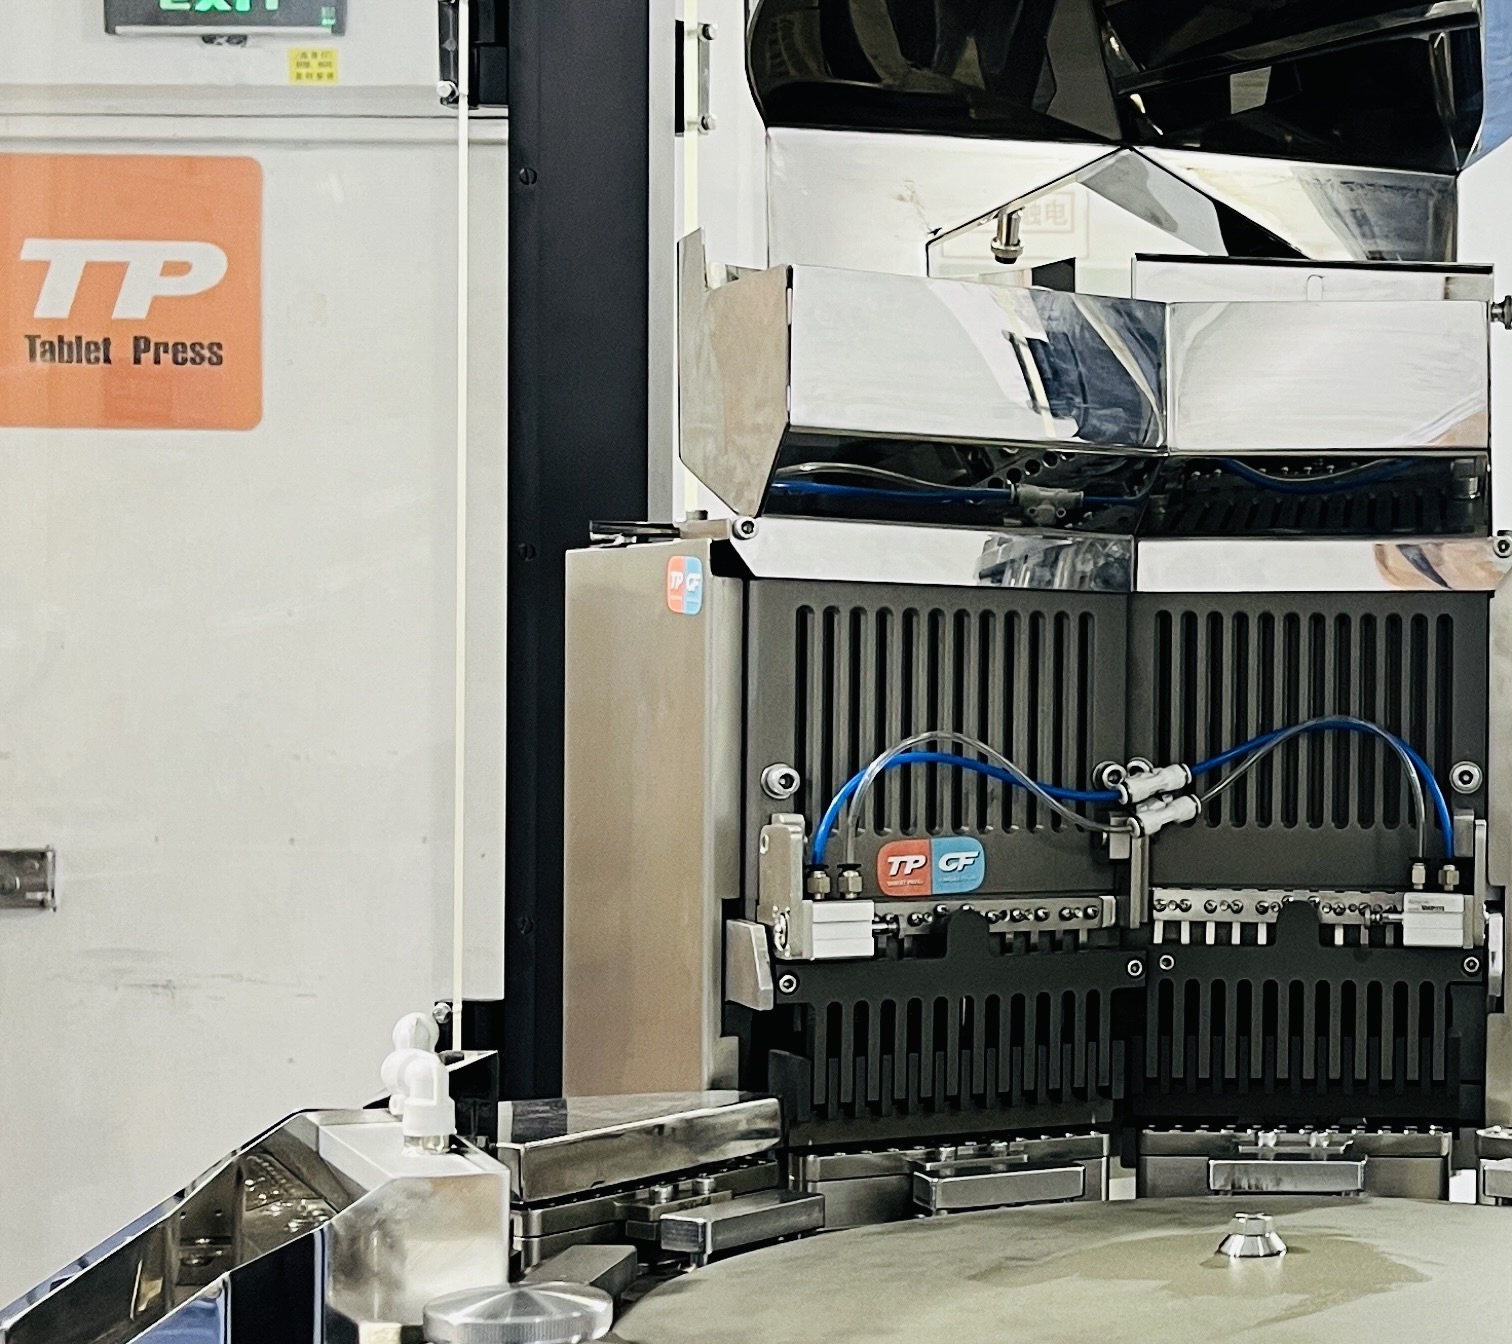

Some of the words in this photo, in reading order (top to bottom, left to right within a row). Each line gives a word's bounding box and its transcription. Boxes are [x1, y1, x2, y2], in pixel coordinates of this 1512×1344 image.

[20, 237, 229, 321] TP
[23, 334, 113, 365] Tablet
[132, 335, 225, 367] Press
[887, 854, 928, 877] TP
